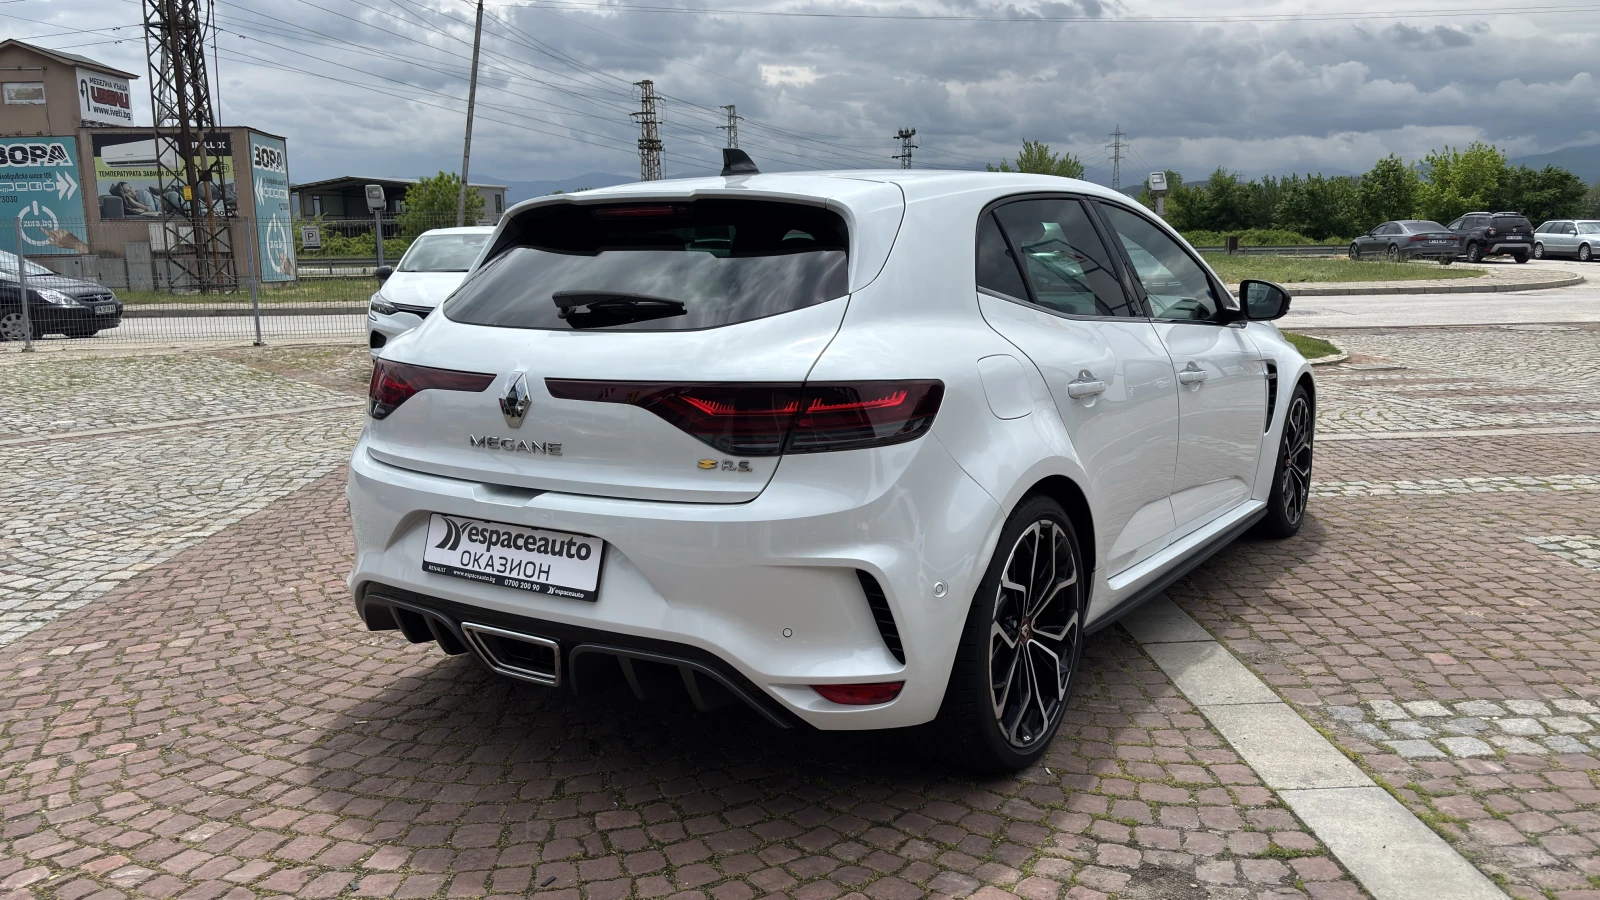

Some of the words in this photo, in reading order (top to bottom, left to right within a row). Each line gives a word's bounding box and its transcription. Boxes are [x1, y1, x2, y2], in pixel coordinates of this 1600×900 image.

[93, 106, 131, 121] www.iveli.bg
[254, 144, 285, 172] ЗОРА
[23, 219, 52, 228] zora.bg
[469, 434, 563, 456] MEGANE
[721, 459, 753, 472] R.S.
[467, 526, 592, 561] espaceauto
[460, 550, 551, 582] ОКАЗИОН
[428, 565, 447, 573] RENAULT
[453, 570, 496, 584] www.espaceauto.bg
[504, 579, 519, 588] 0700
[520, 582, 532, 591] 200
[532, 583, 540, 592] 90
[555, 589, 585, 599] espaceauto
